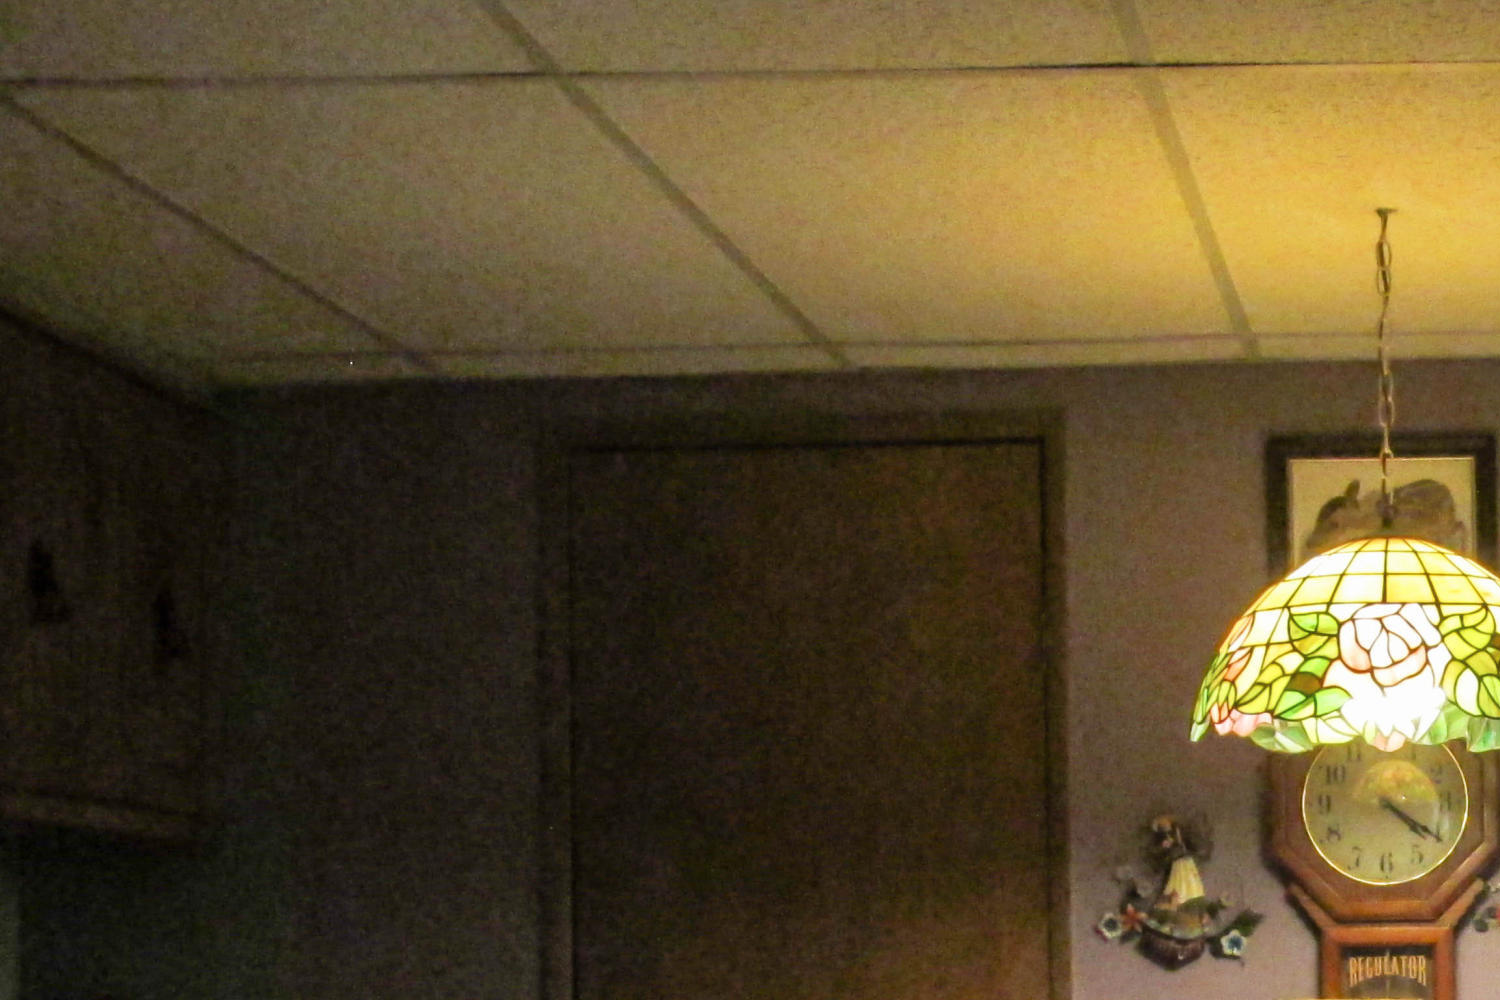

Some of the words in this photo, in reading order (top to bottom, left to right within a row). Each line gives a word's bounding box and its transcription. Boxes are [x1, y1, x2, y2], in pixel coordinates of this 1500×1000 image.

[1325, 765, 1346, 785] 10
[1318, 795, 1331, 815] 9
[1347, 846, 1362, 871] 7
[1380, 853, 1393, 874] 6
[1411, 844, 1424, 865] 5
[1349, 955, 1426, 987] REGULATOR
